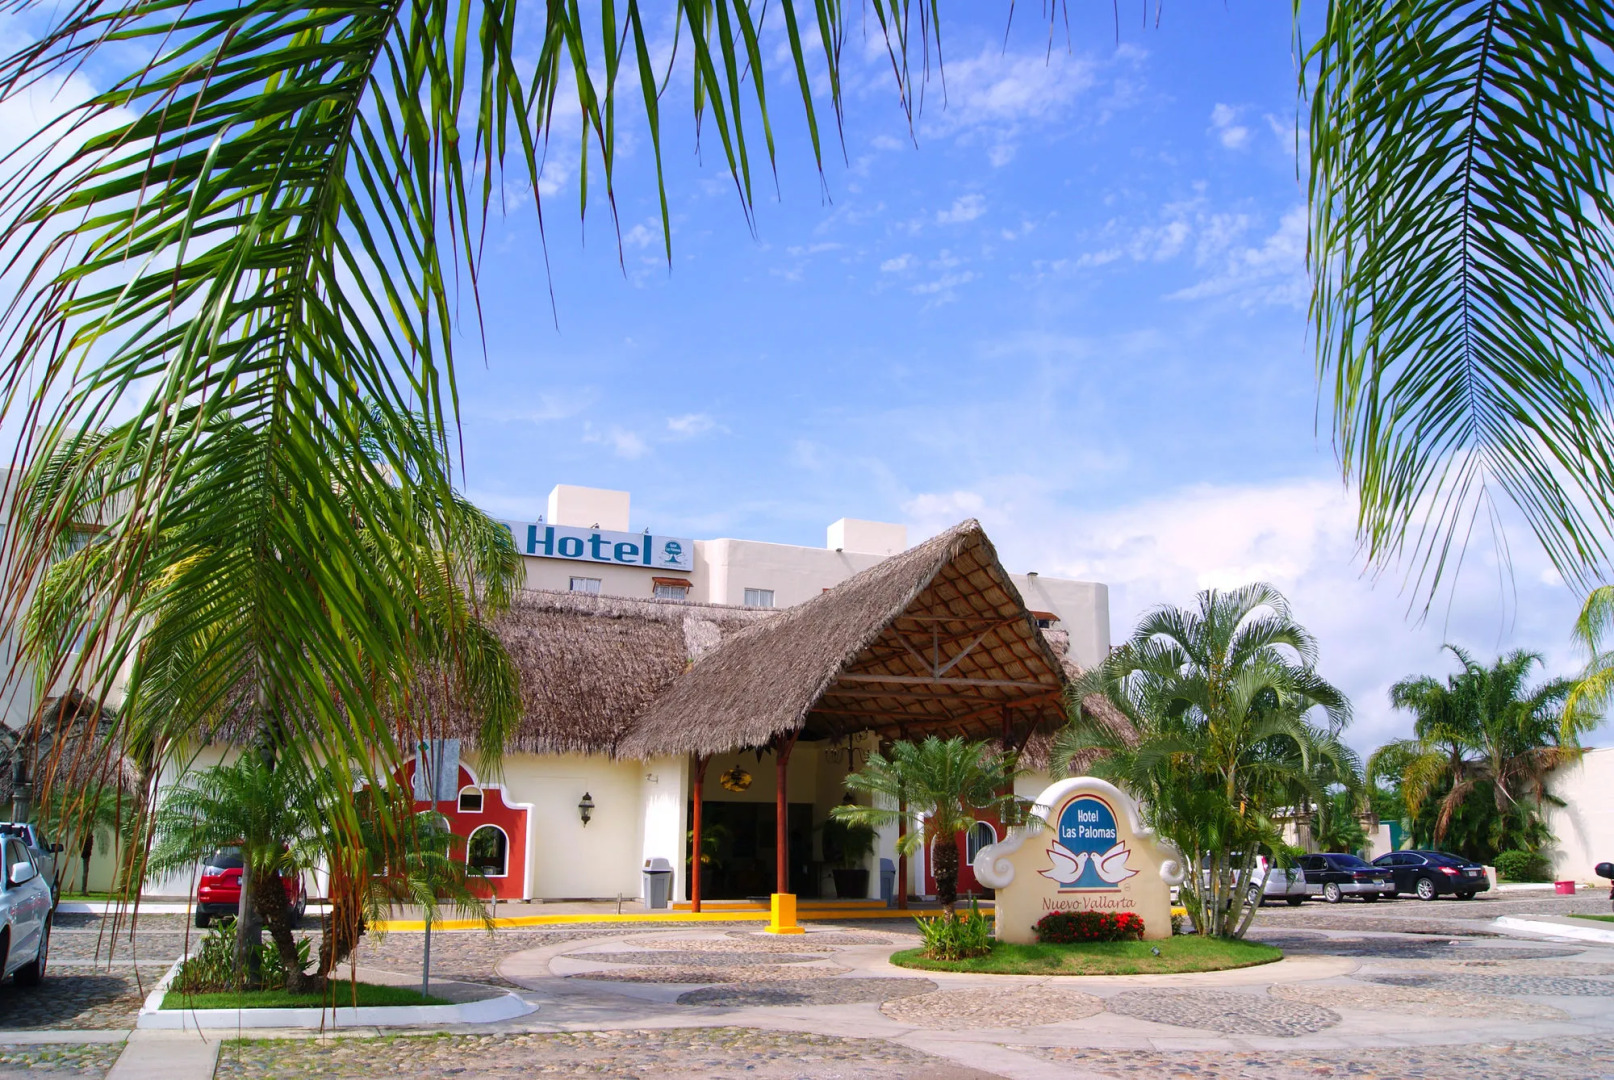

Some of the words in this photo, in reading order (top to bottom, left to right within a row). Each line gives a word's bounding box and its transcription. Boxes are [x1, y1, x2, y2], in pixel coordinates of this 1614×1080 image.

[526, 524, 652, 565] Hotel
[1077, 809, 1099, 823] Hotel
[1062, 825, 1077, 838] Las
[1079, 825, 1116, 839] Palomas
[1042, 897, 1081, 911] Nuevo
[1082, 896, 1136, 910] Vallarta
